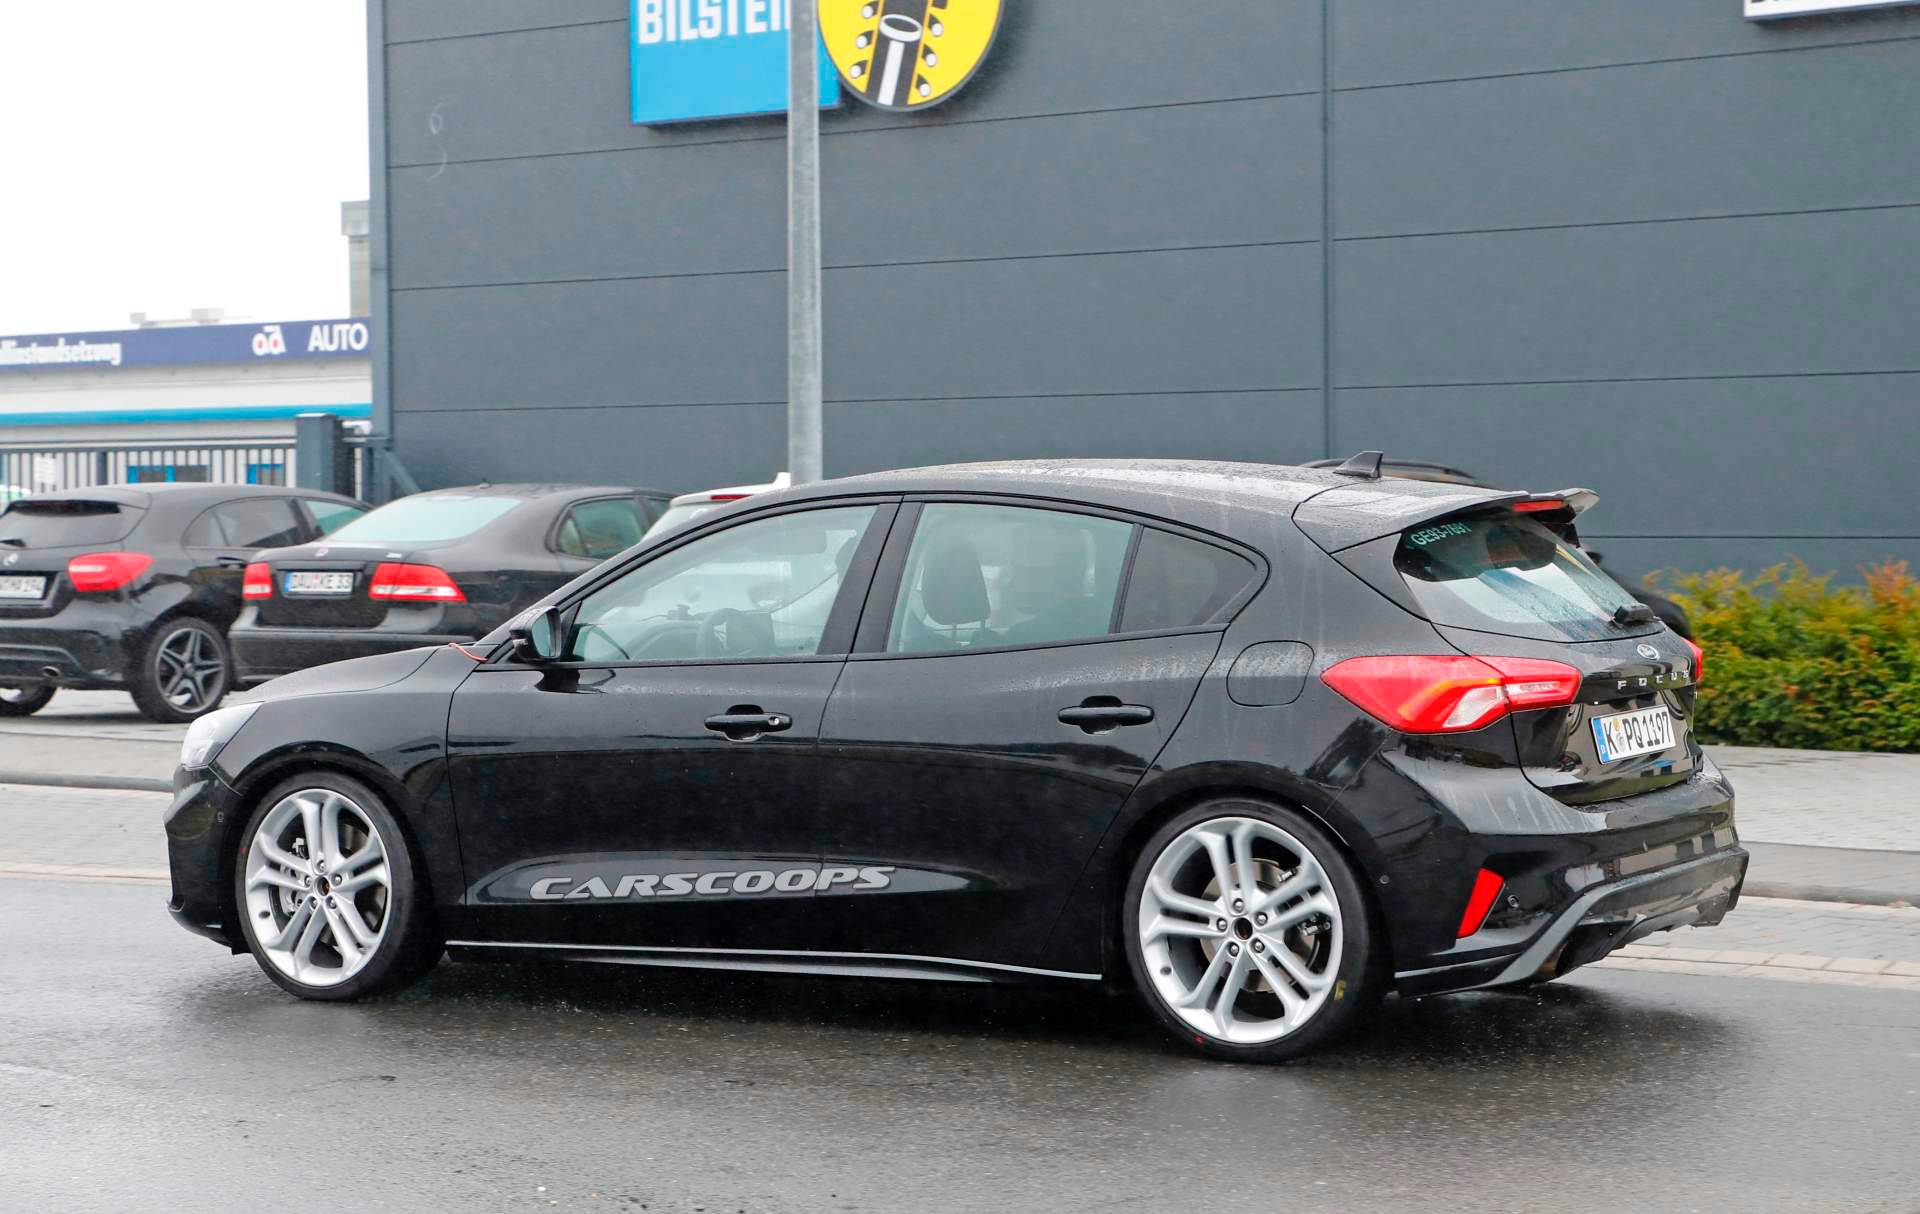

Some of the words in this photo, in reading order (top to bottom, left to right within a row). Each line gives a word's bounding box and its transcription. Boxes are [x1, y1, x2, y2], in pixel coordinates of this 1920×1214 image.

[307, 322, 368, 352] AUTO
[1617, 669, 1690, 690] FOCUS
[1604, 721, 1618, 754] K
[1622, 716, 1645, 751] PQ
[1643, 711, 1671, 748] 1197
